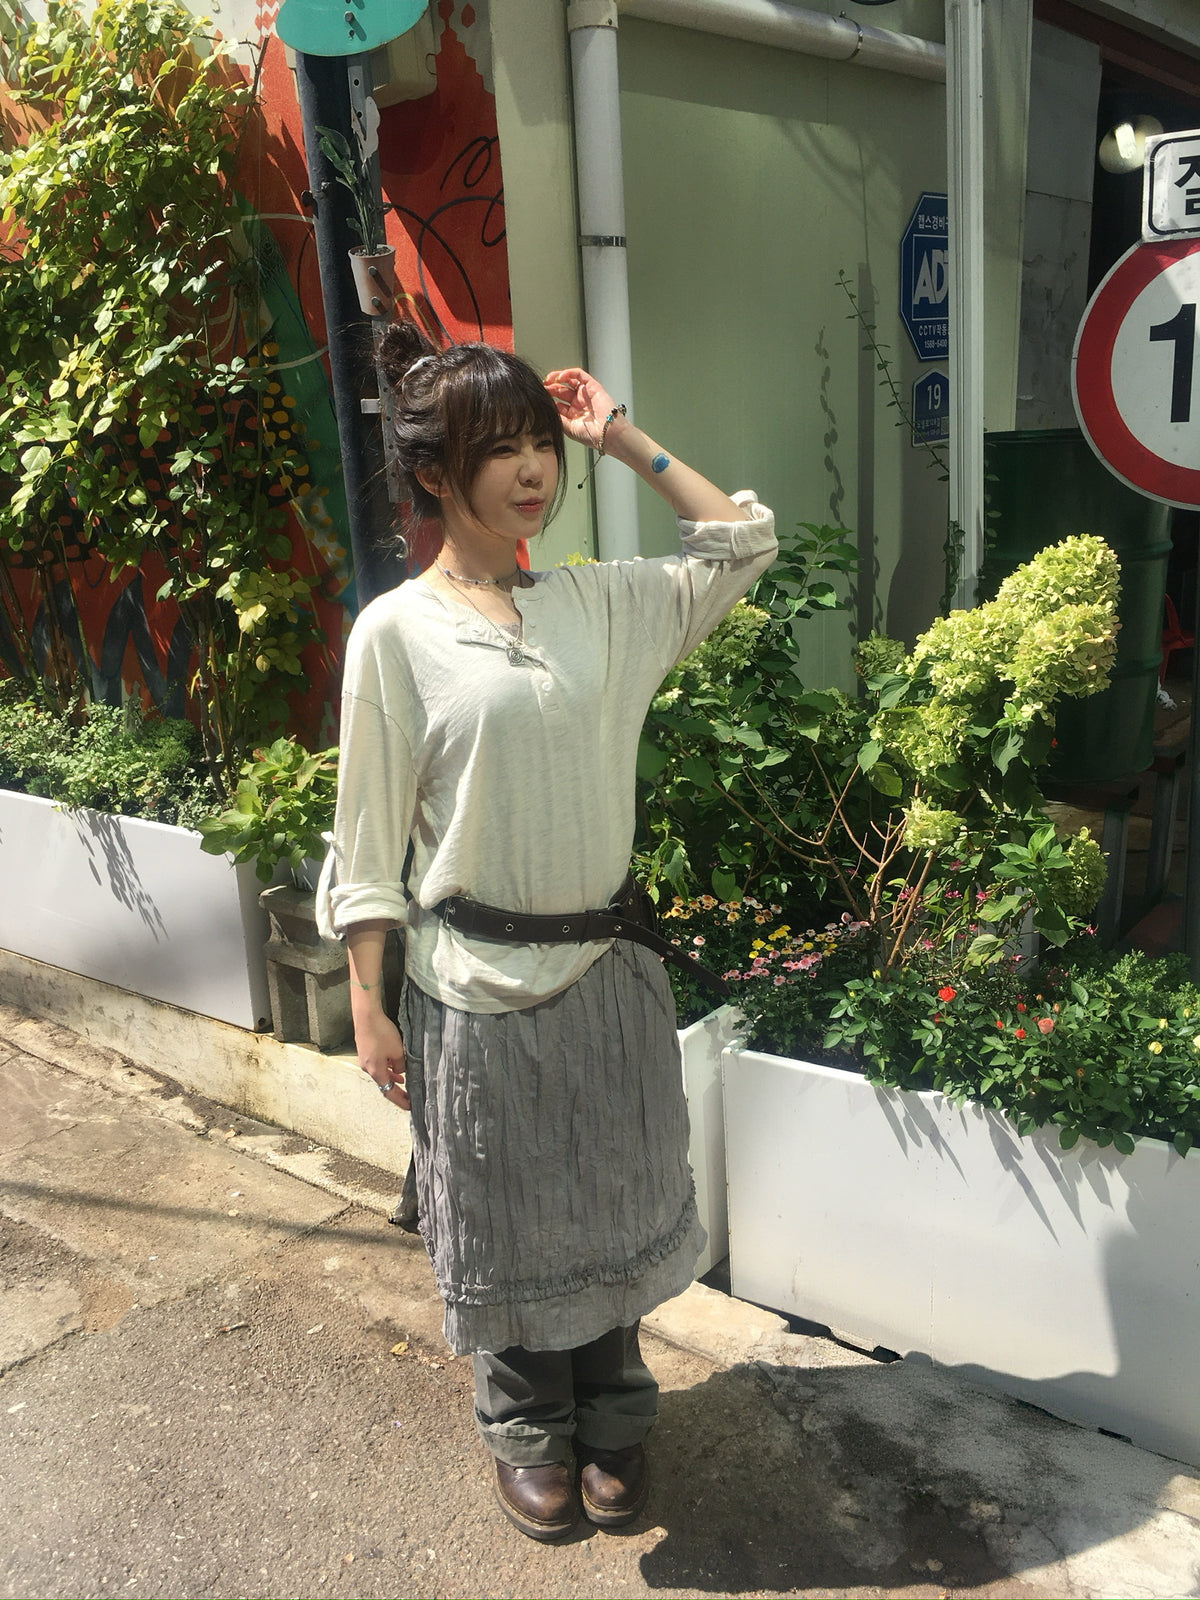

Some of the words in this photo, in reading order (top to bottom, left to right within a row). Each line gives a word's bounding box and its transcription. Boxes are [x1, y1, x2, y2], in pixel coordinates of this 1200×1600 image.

[918, 214, 949, 230] 캡스경비
[913, 248, 949, 304] AD
[927, 383, 942, 410] 19
